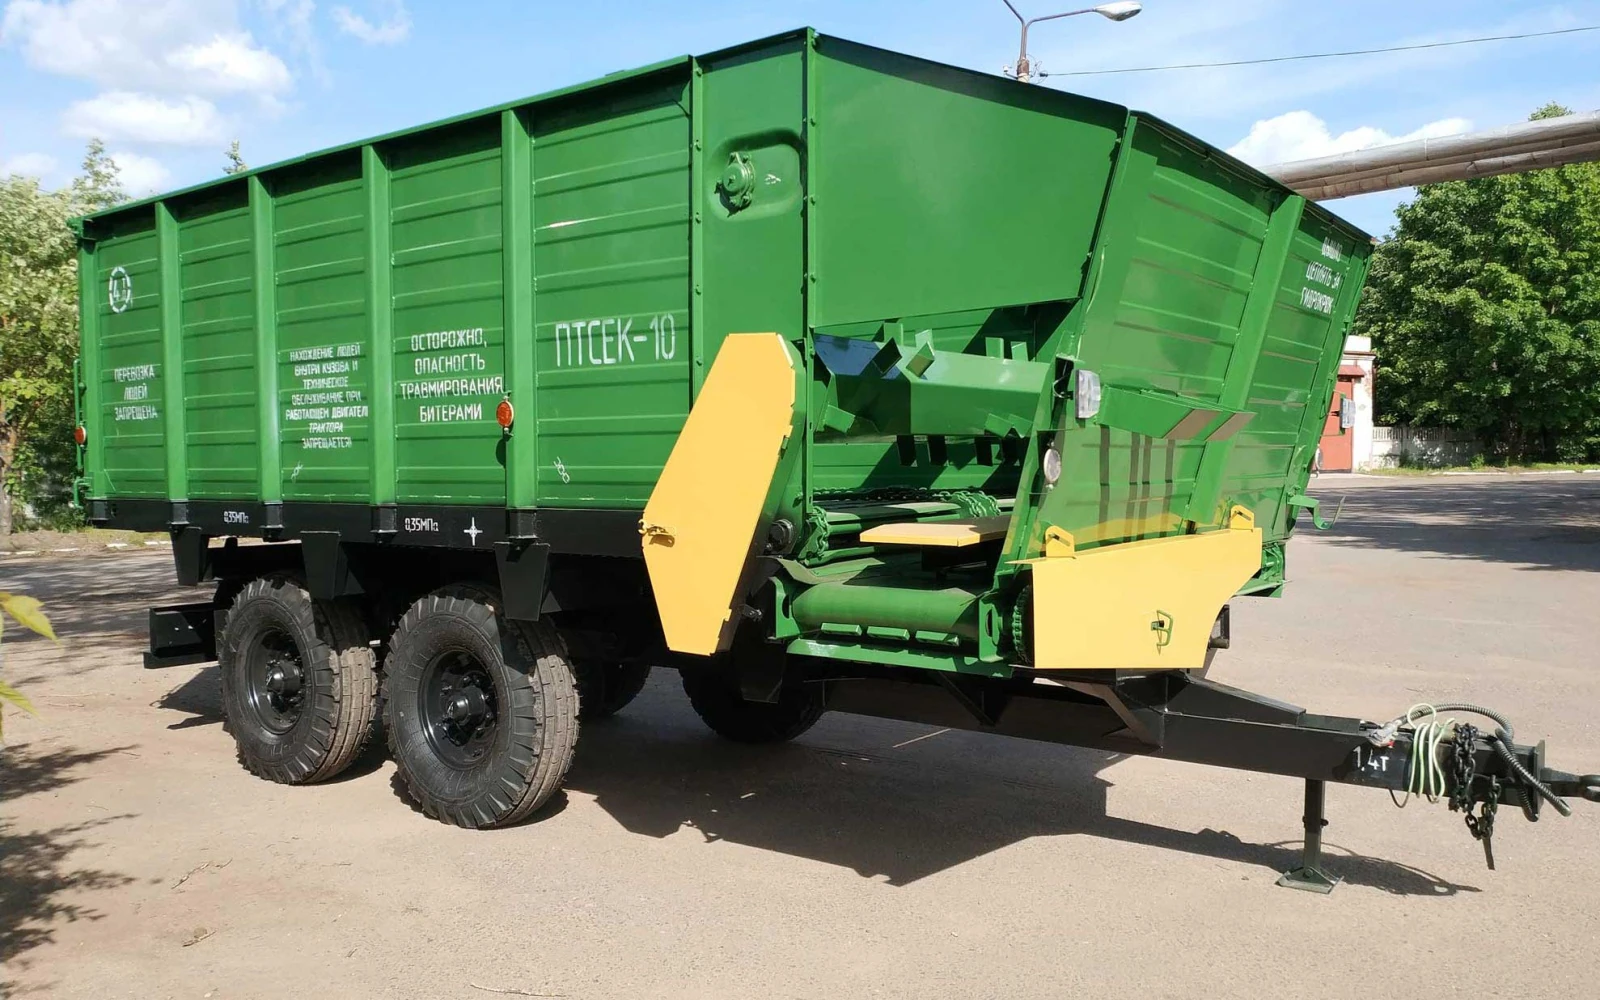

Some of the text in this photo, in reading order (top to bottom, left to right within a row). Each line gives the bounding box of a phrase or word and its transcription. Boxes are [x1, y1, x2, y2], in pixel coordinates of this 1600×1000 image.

[411, 327, 488, 352] ОСТОРОЖНО,
[555, 313, 676, 367] ПТСЕК-10
[290, 342, 361, 361] НАХОЖДЕНИЕ ЛЮДЕЙ
[114, 364, 156, 383] ПЕРЕВОЗКА
[294, 359, 359, 377] ВНУТРИ КУЗОВА И
[414, 353, 486, 375] ОПАСНОСТЬ
[124, 382, 148, 401] ЛЮДЕЙ
[303, 376, 349, 390] ТЕХНИЧЕСКОЕ
[400, 376, 505, 401] ТРАВМИРОВАНИЯ
[292, 390, 362, 406] ОБСЛУЖИВАНИЕ ПРИ
[114, 404, 158, 421] ЗАПРЕЩЕНА
[285, 407, 330, 421] РАБОТАЮЩЕМ
[419, 403, 483, 423] БИТЕРАМИ
[309, 421, 344, 434] ТРАКТОРА
